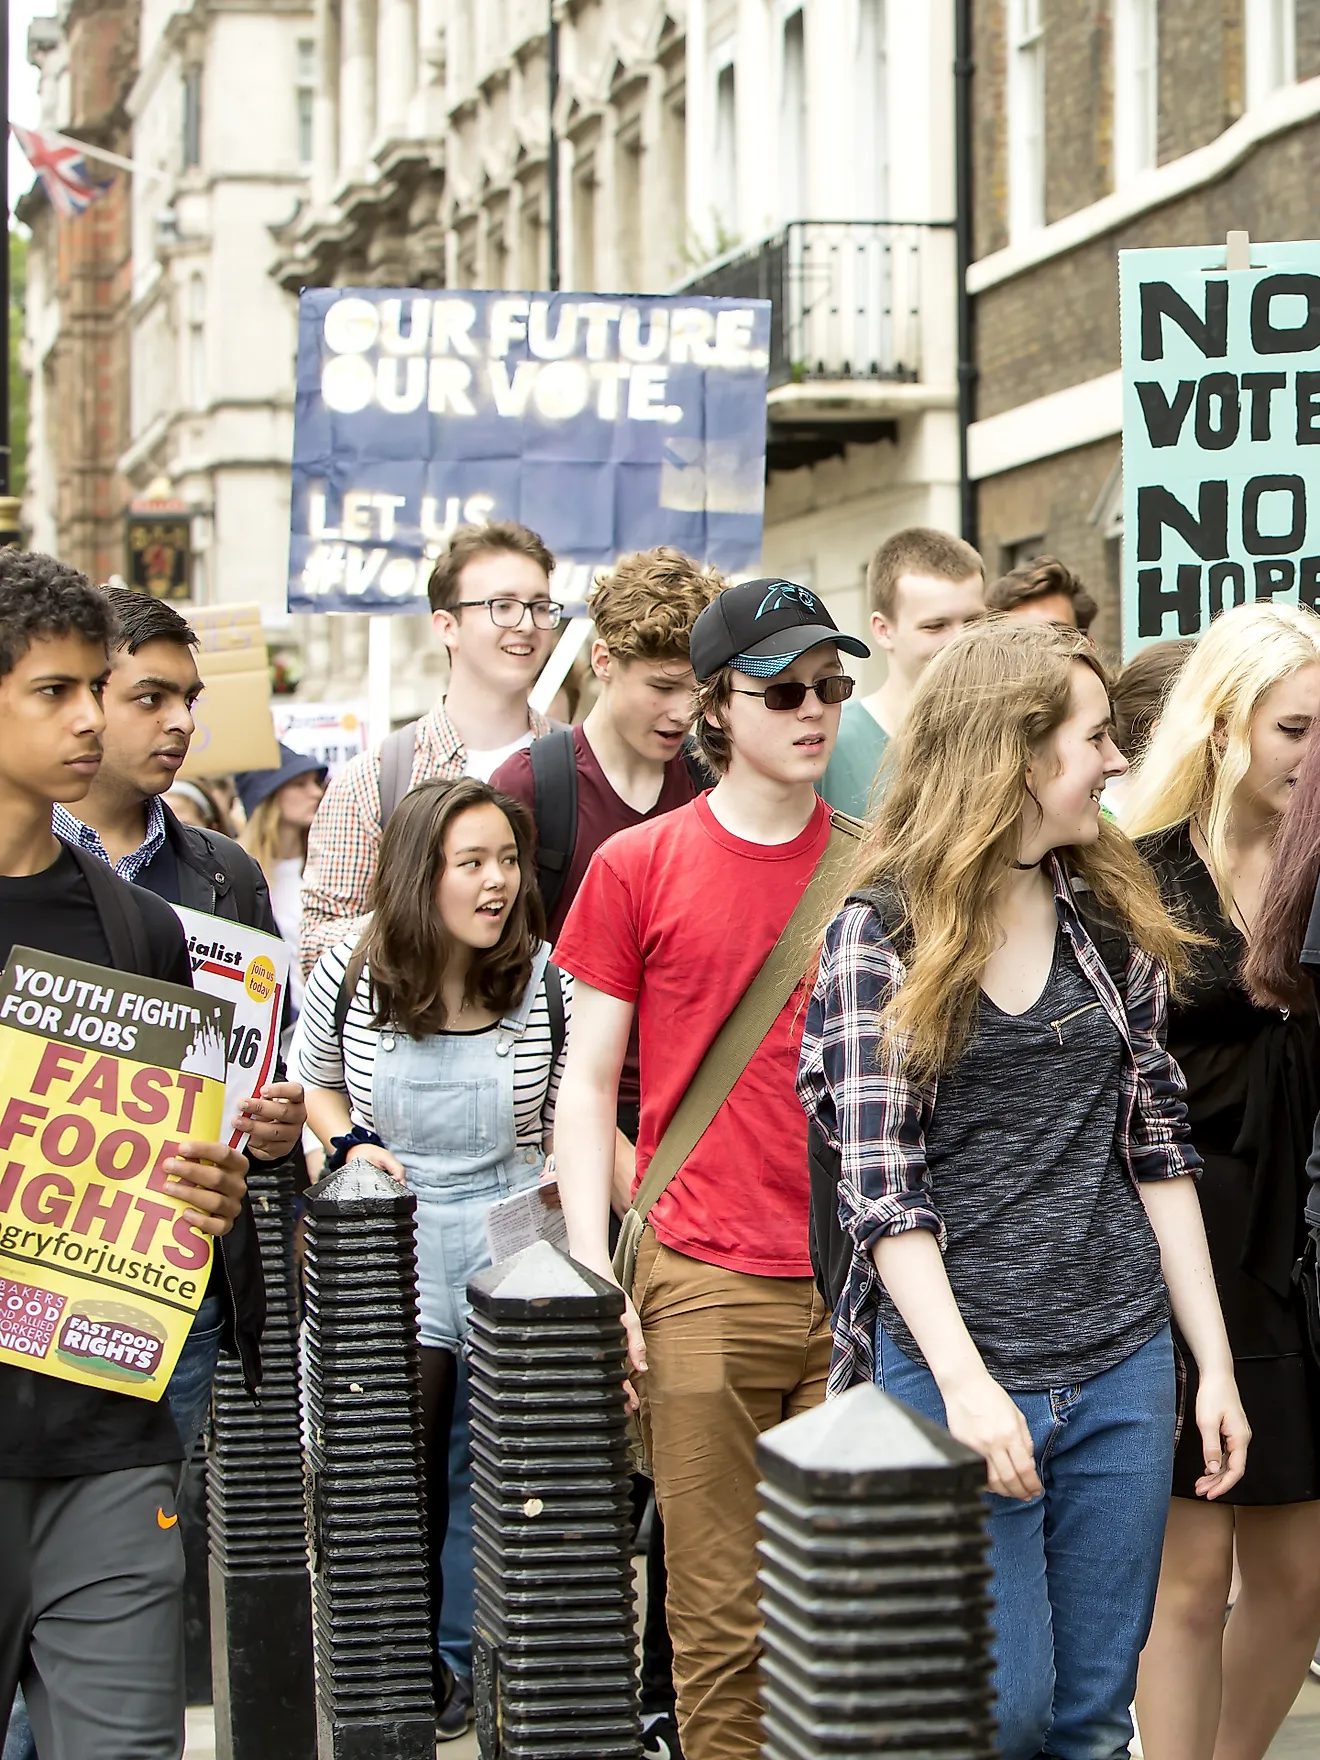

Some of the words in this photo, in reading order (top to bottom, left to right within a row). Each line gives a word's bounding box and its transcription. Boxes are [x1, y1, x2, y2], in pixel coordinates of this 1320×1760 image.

[323, 297, 479, 357] OUR
[489, 302, 770, 369] FUTURE.
[321, 353, 477, 416] OUR
[488, 360, 684, 424] VOTE.
[308, 493, 405, 540] LET
[420, 492, 495, 540] US
[1137, 474, 1307, 562] NO
[185, 936, 243, 966] ialist
[251, 961, 265, 978] join
[266, 970, 275, 982] us
[14, 964, 115, 1014] YOUTH
[117, 992, 191, 1031] FIGHT
[250, 978, 270, 999] today
[0, 994, 62, 1033] FOR
[63, 1012, 139, 1052] JOBS
[228, 1025, 262, 1069] 16
[29, 1041, 204, 1134] FAST
[0, 1160, 210, 1271] IGHTS
[0, 1223, 197, 1299] gryforjustice
[0, 1308, 16, 1319] ND
[19, 1315, 55, 1332] ALLIED
[0, 1318, 51, 1344] ORKERS
[69, 1317, 111, 1338] FAST
[111, 1329, 159, 1352] FOOD
[0, 1331, 48, 1357] NION
[63, 1331, 155, 1369] RIGHTS
